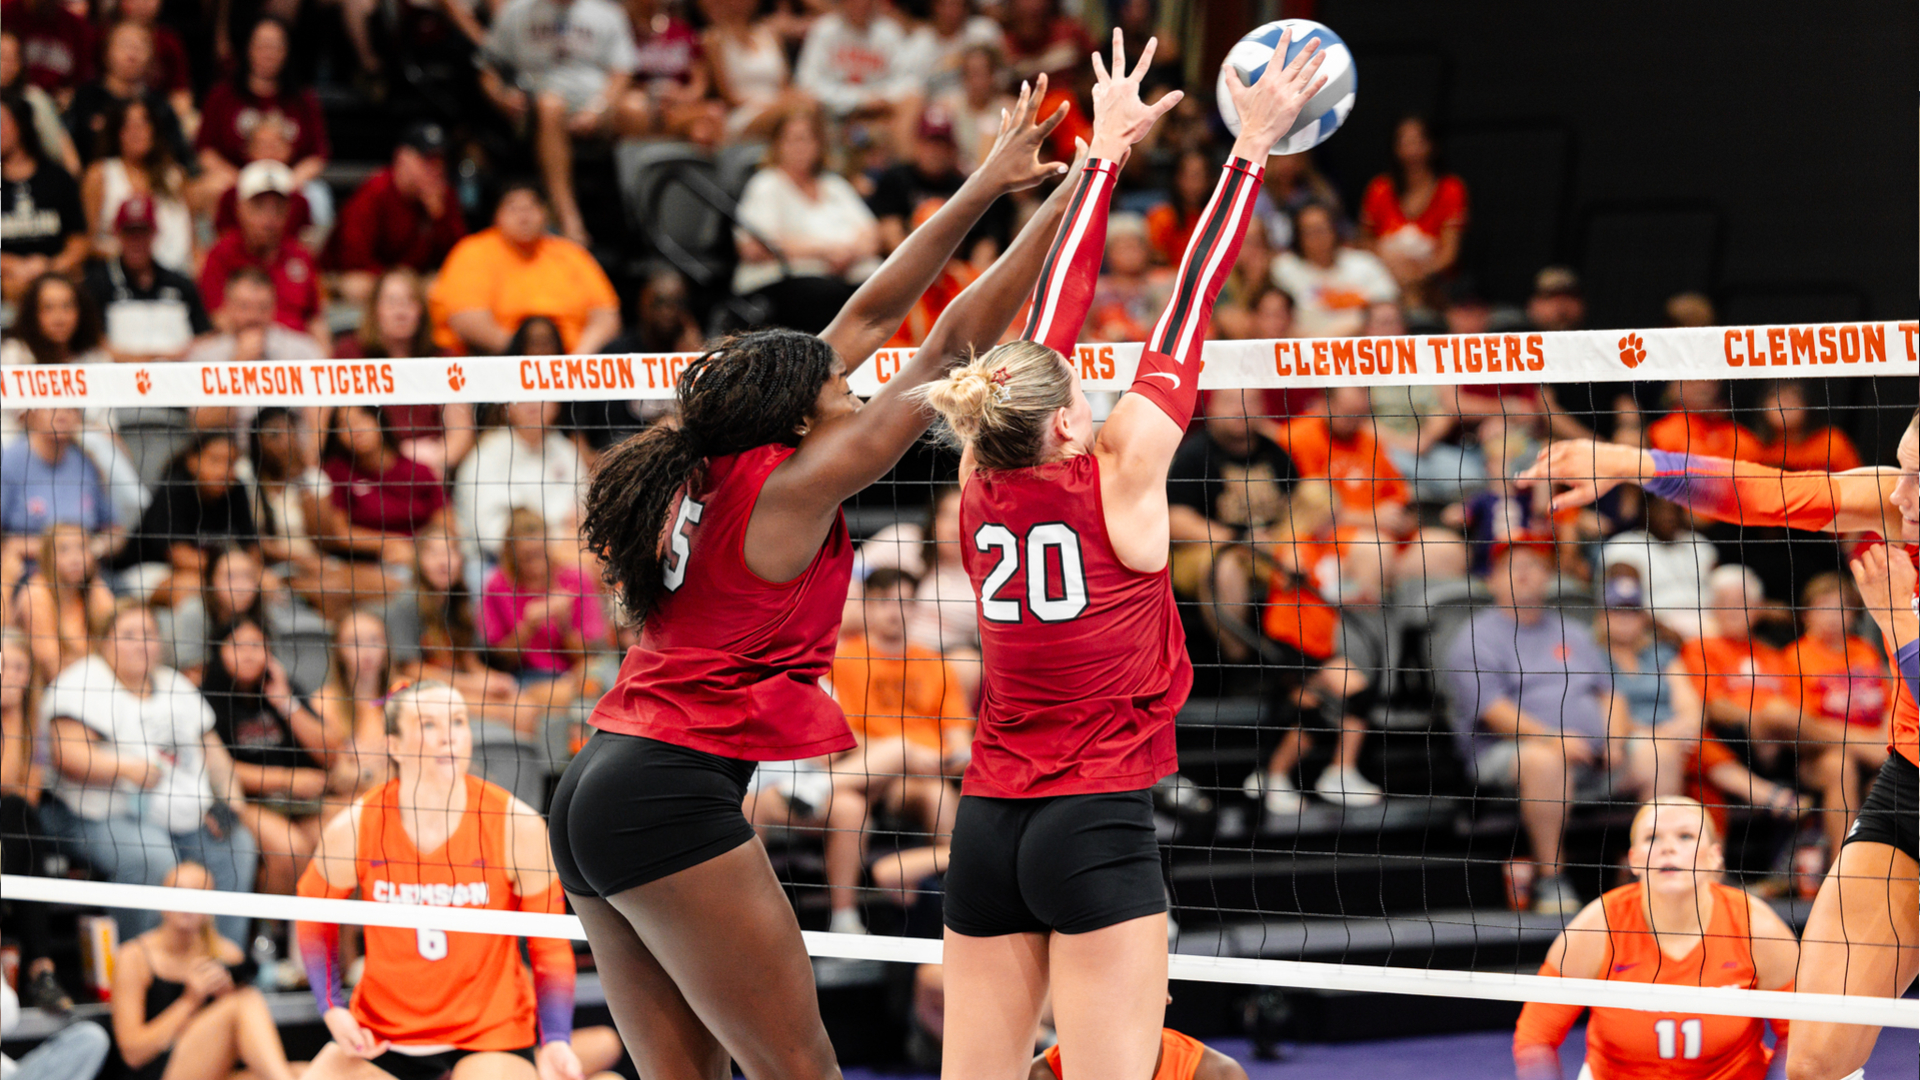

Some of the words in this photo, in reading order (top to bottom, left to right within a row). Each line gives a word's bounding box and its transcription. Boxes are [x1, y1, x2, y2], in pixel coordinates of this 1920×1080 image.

[1274, 338, 1418, 377] CLEMSON
[1427, 334, 1545, 374] TIGERS
[1724, 324, 1887, 367] CLEMSON
[12, 369, 88, 397] TIGERS
[201, 366, 304, 395] CLEMSON
[310, 364, 395, 395] TIGERS
[520, 357, 635, 390] CLEMSON
[642, 356, 700, 389] TIG
[662, 492, 706, 594] 5
[974, 521, 1091, 624] 20
[372, 879, 490, 906] CLEMSON
[416, 928, 449, 961] 6
[1655, 1018, 1702, 1060] 11
